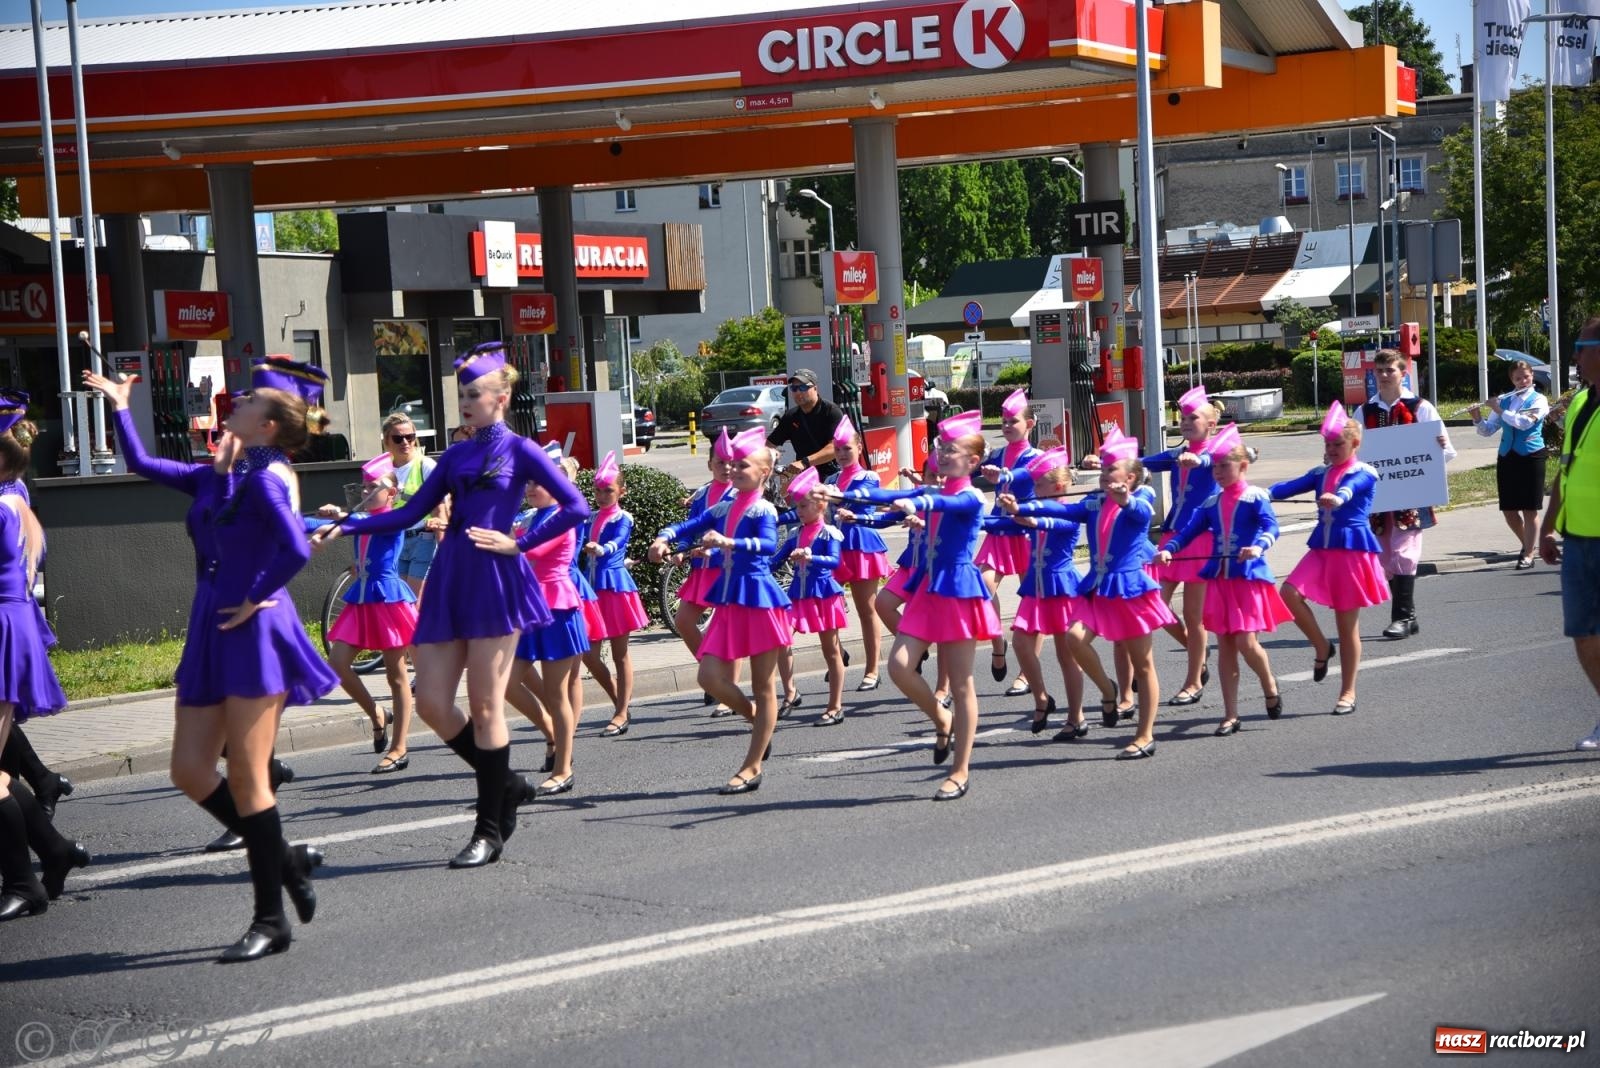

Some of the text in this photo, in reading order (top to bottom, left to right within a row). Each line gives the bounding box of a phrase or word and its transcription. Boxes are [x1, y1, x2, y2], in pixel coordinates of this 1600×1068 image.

[758, 3, 1021, 73] CIRCLE K
[749, 99, 768, 107] max.
[769, 97, 789, 105] 4,5m
[1074, 211, 1120, 236] TIR
[889, 305, 899, 319] 8
[1111, 302, 1119, 314] 7
[1404, 453, 1433, 466] DĘTA
[1388, 468, 1425, 481] NĘDZA
